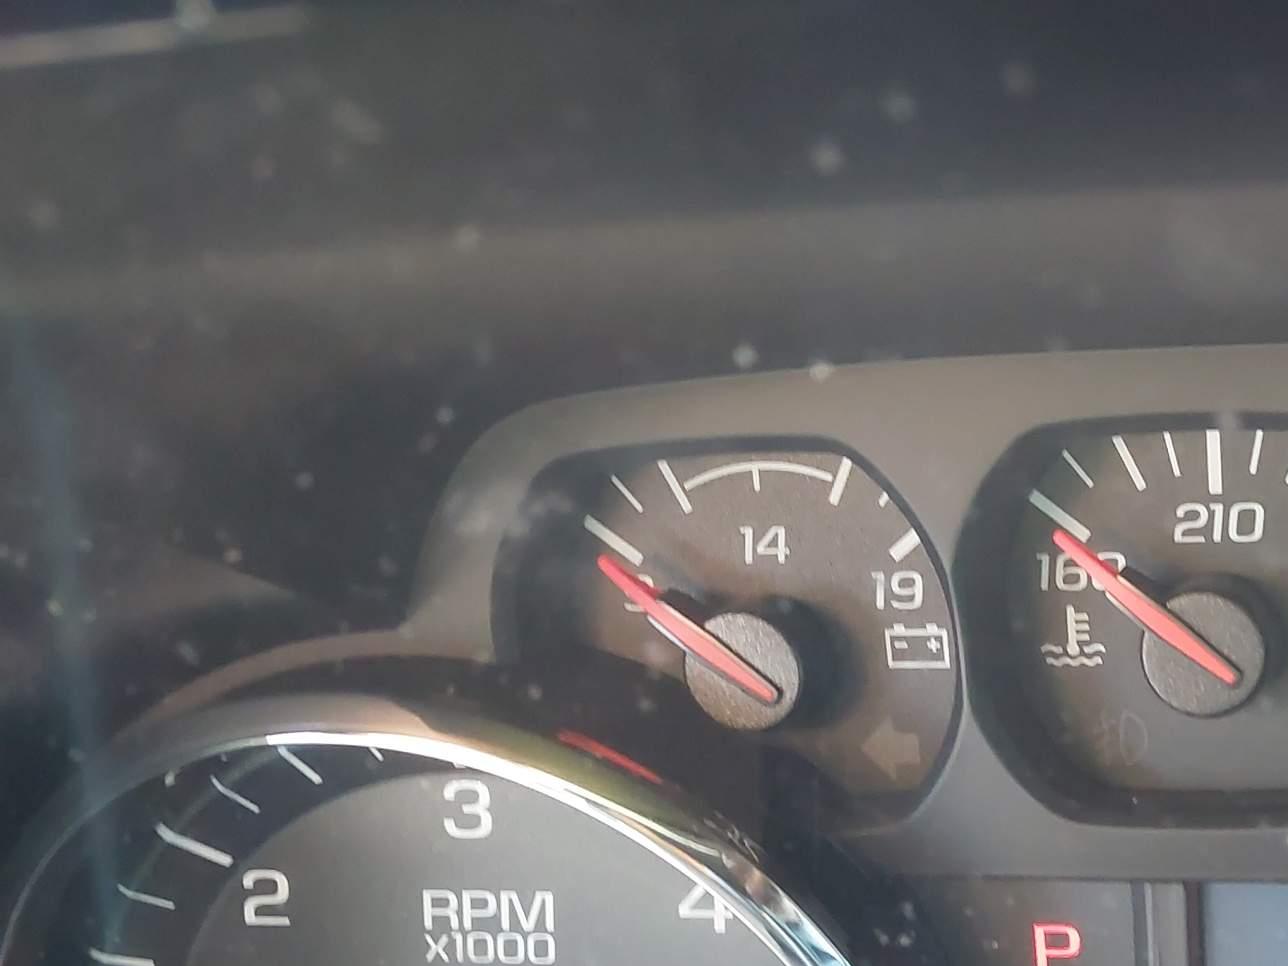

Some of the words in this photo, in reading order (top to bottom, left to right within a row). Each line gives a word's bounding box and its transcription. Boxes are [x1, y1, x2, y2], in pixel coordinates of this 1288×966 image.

[1173, 502, 1265, 543] 210
[739, 525, 790, 564] 14
[871, 570, 924, 610] 19
[443, 779, 492, 840] 3
[242, 869, 291, 927] 2
[423, 889, 555, 932] RPM
[678, 882, 735, 934] 4
[425, 931, 556, 965] x1000
